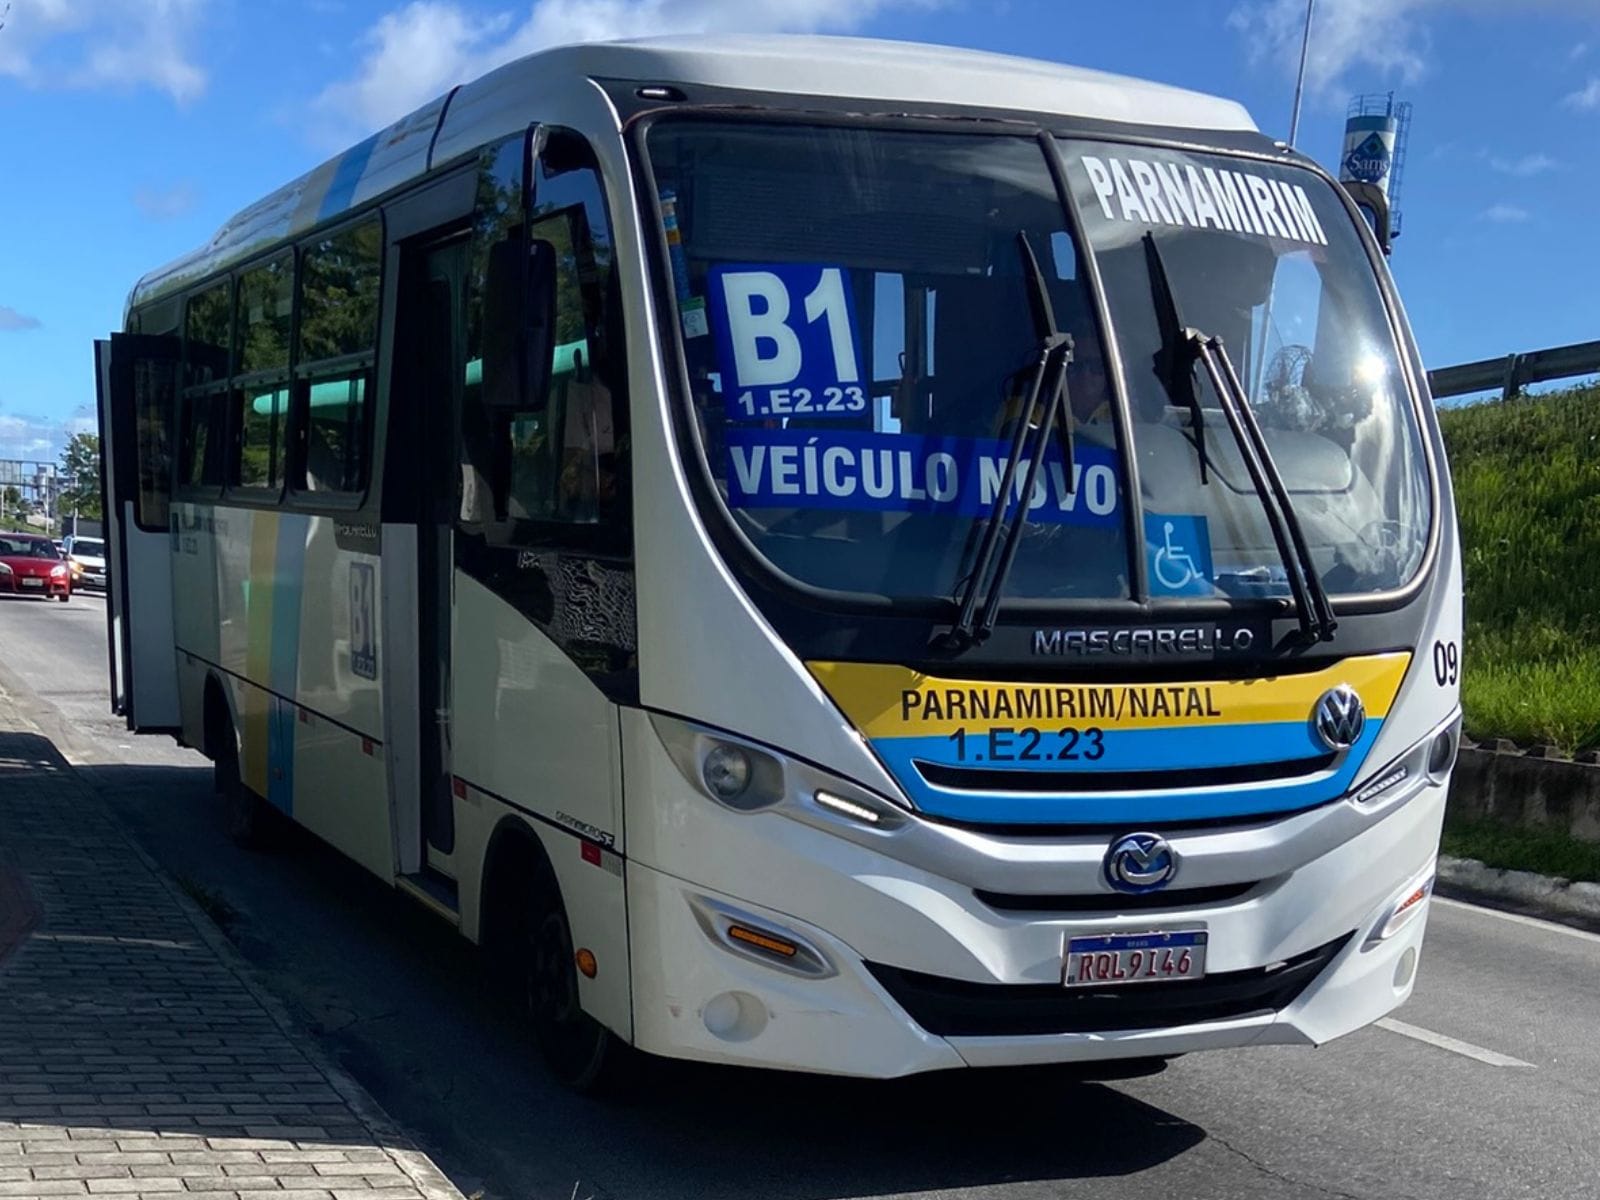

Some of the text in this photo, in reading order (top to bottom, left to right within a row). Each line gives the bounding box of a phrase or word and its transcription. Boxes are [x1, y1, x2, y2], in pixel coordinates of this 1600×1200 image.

[1081, 156, 1328, 246] PARNAMIRIM
[721, 268, 859, 387] B1
[738, 386, 866, 415] 1.E2.23
[729, 437, 1117, 516] VEÍCULO NOVO
[1034, 628, 1254, 655] MASCARELLO
[1434, 640, 1458, 687] 09
[901, 687, 1221, 721] PARNAMIRIM/NATAL
[948, 727, 1105, 762] 1.E2.23
